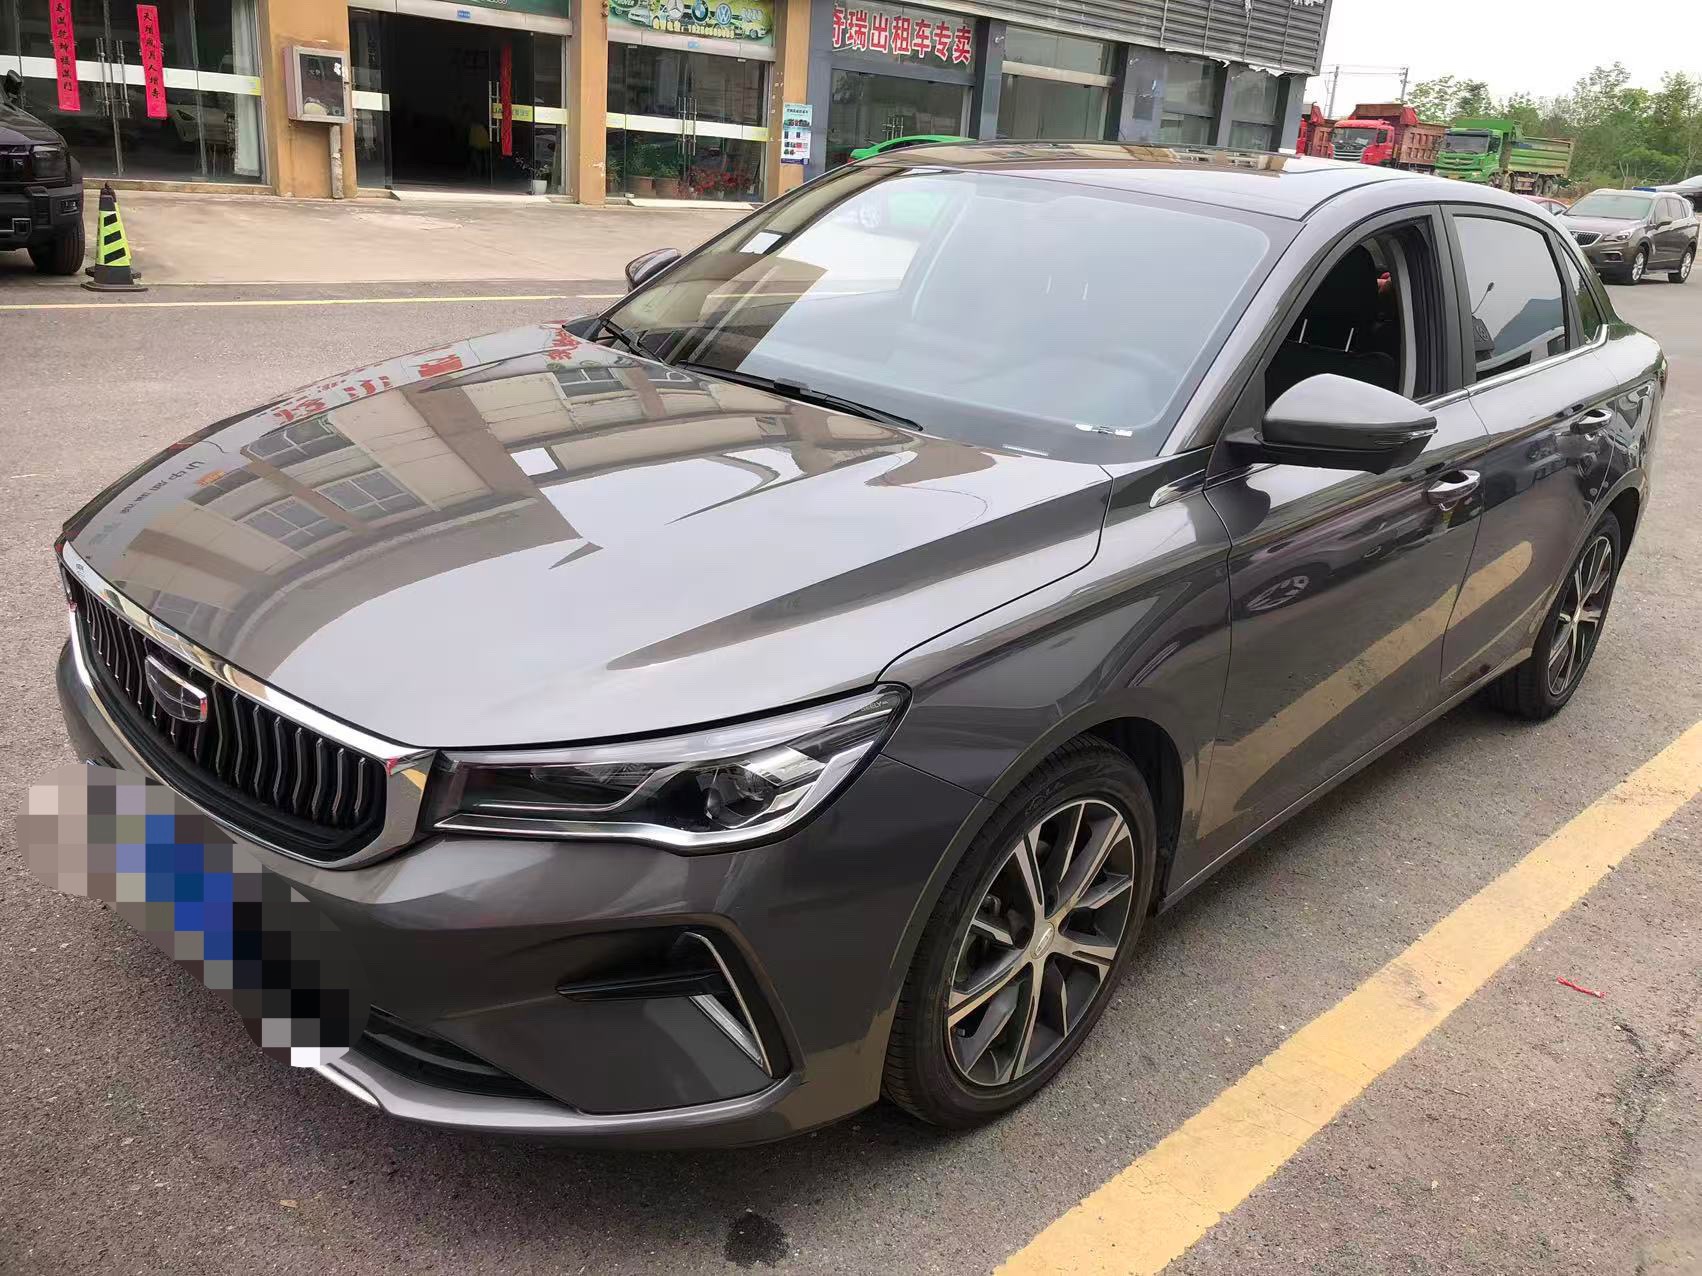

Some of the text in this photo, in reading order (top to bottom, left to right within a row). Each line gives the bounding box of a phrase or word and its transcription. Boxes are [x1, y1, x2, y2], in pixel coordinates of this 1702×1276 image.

[832, 7, 973, 64] 奇瑞出租车专卖
